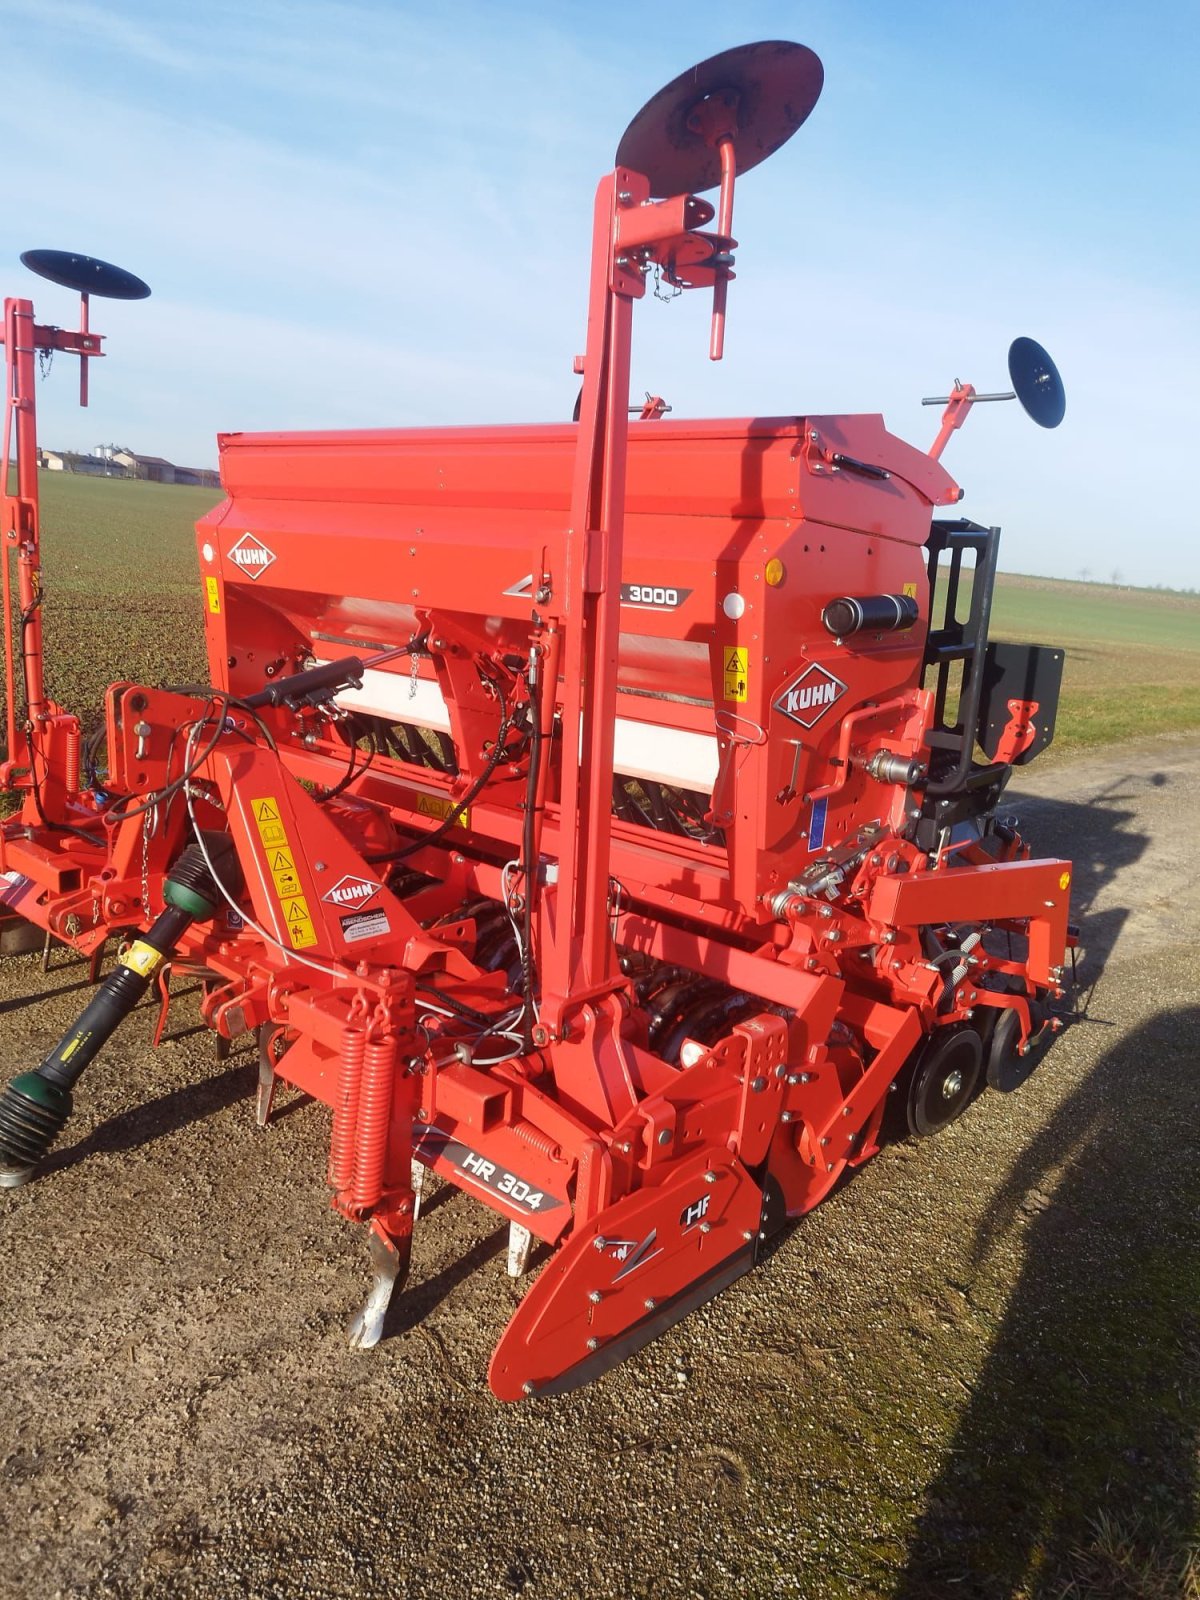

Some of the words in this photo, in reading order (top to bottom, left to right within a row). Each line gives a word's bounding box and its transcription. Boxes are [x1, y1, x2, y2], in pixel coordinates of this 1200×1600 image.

[234, 548, 269, 565] KUHN
[629, 585, 678, 606] 3000
[787, 681, 836, 713] KUHN
[331, 883, 374, 903] KUHN
[462, 1152, 496, 1182] HR
[497, 1173, 544, 1209] 304
